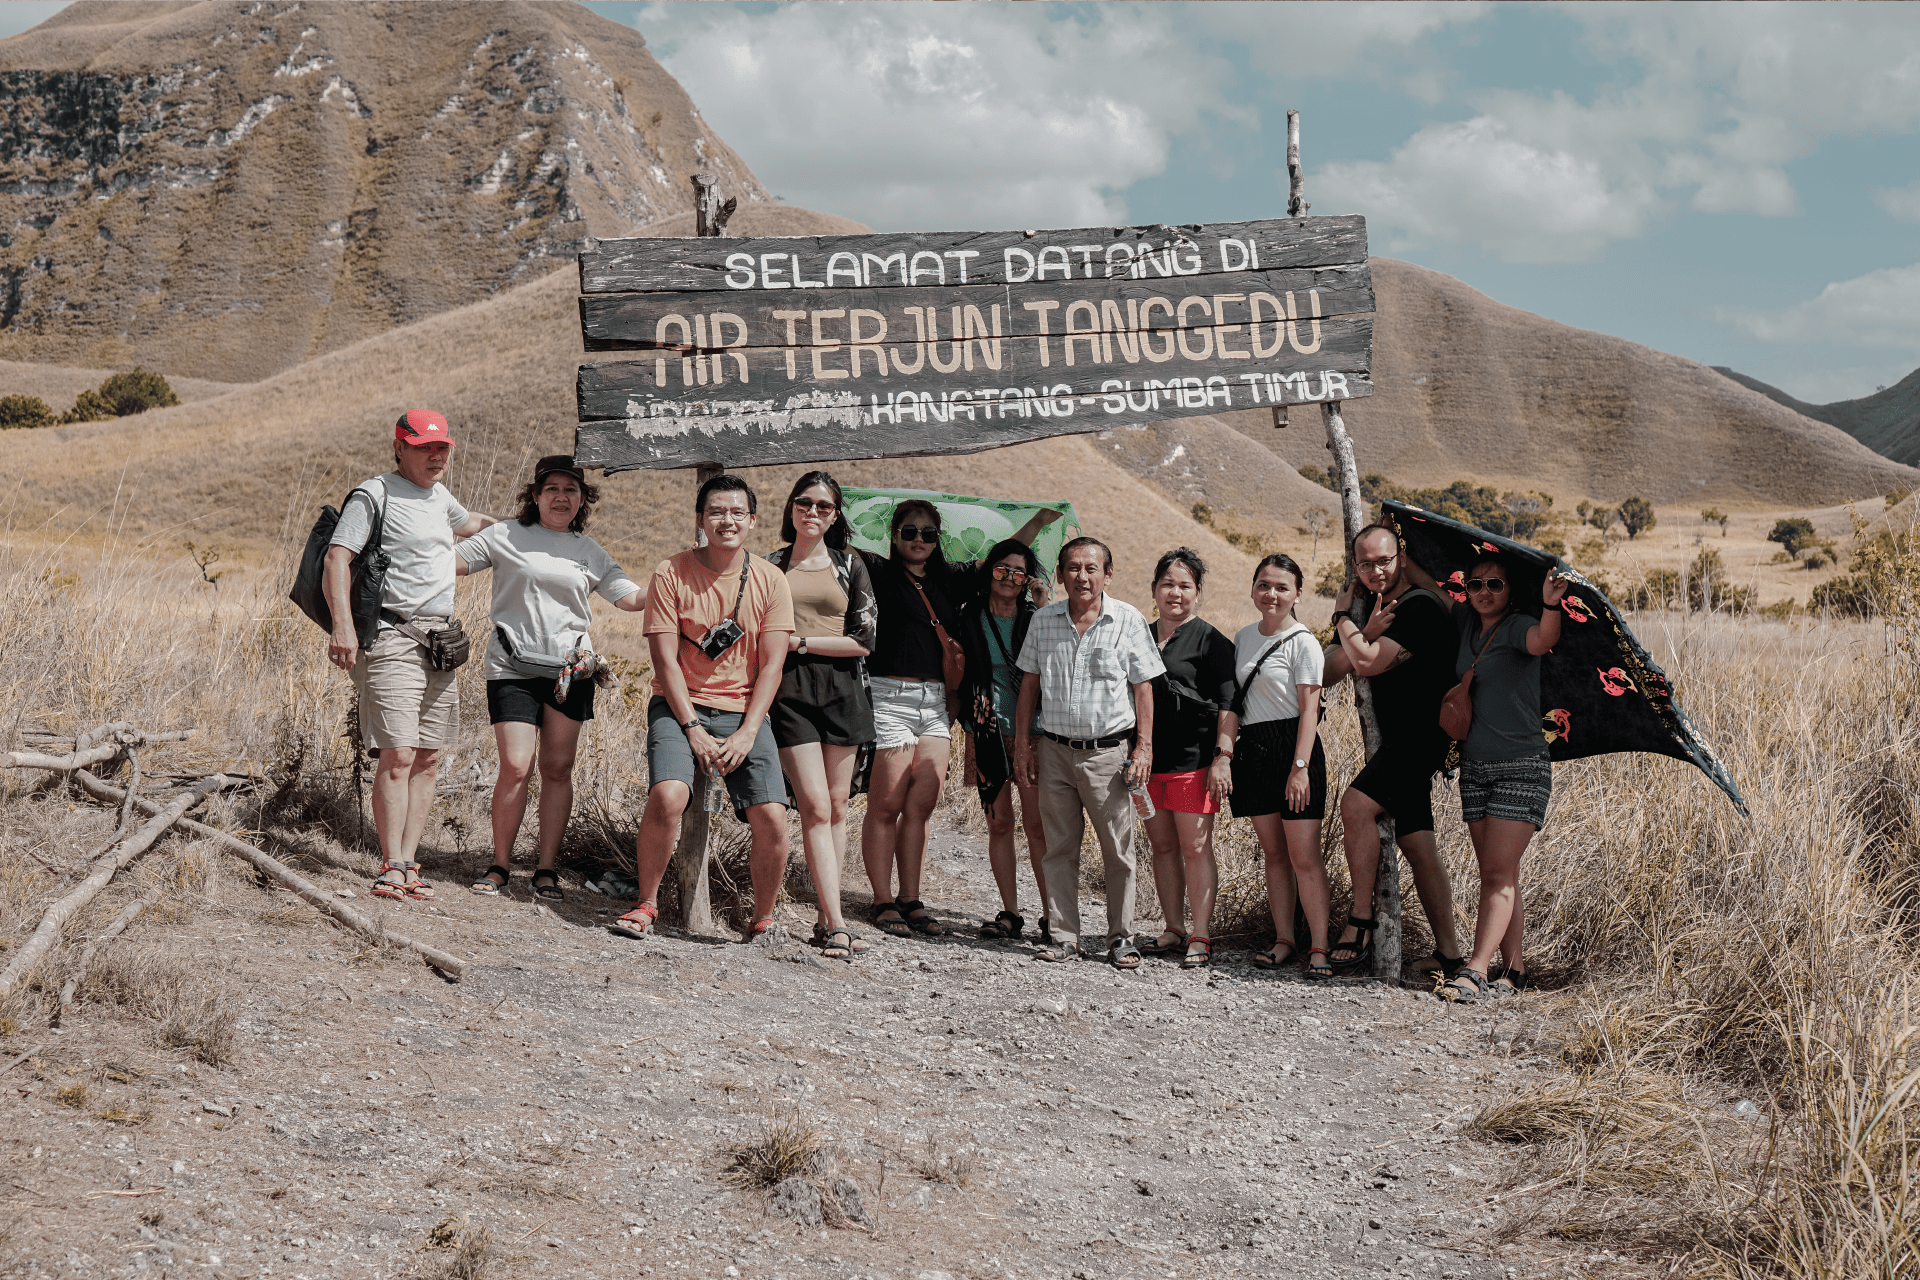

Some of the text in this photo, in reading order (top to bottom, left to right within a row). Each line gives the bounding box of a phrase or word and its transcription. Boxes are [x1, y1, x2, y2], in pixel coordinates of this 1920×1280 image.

[724, 237, 1261, 290] SELAMAT DATANG DI
[655, 289, 1322, 388] AIR TERJUN TANGGEDU
[1240, 370, 1350, 403] TIMUR
